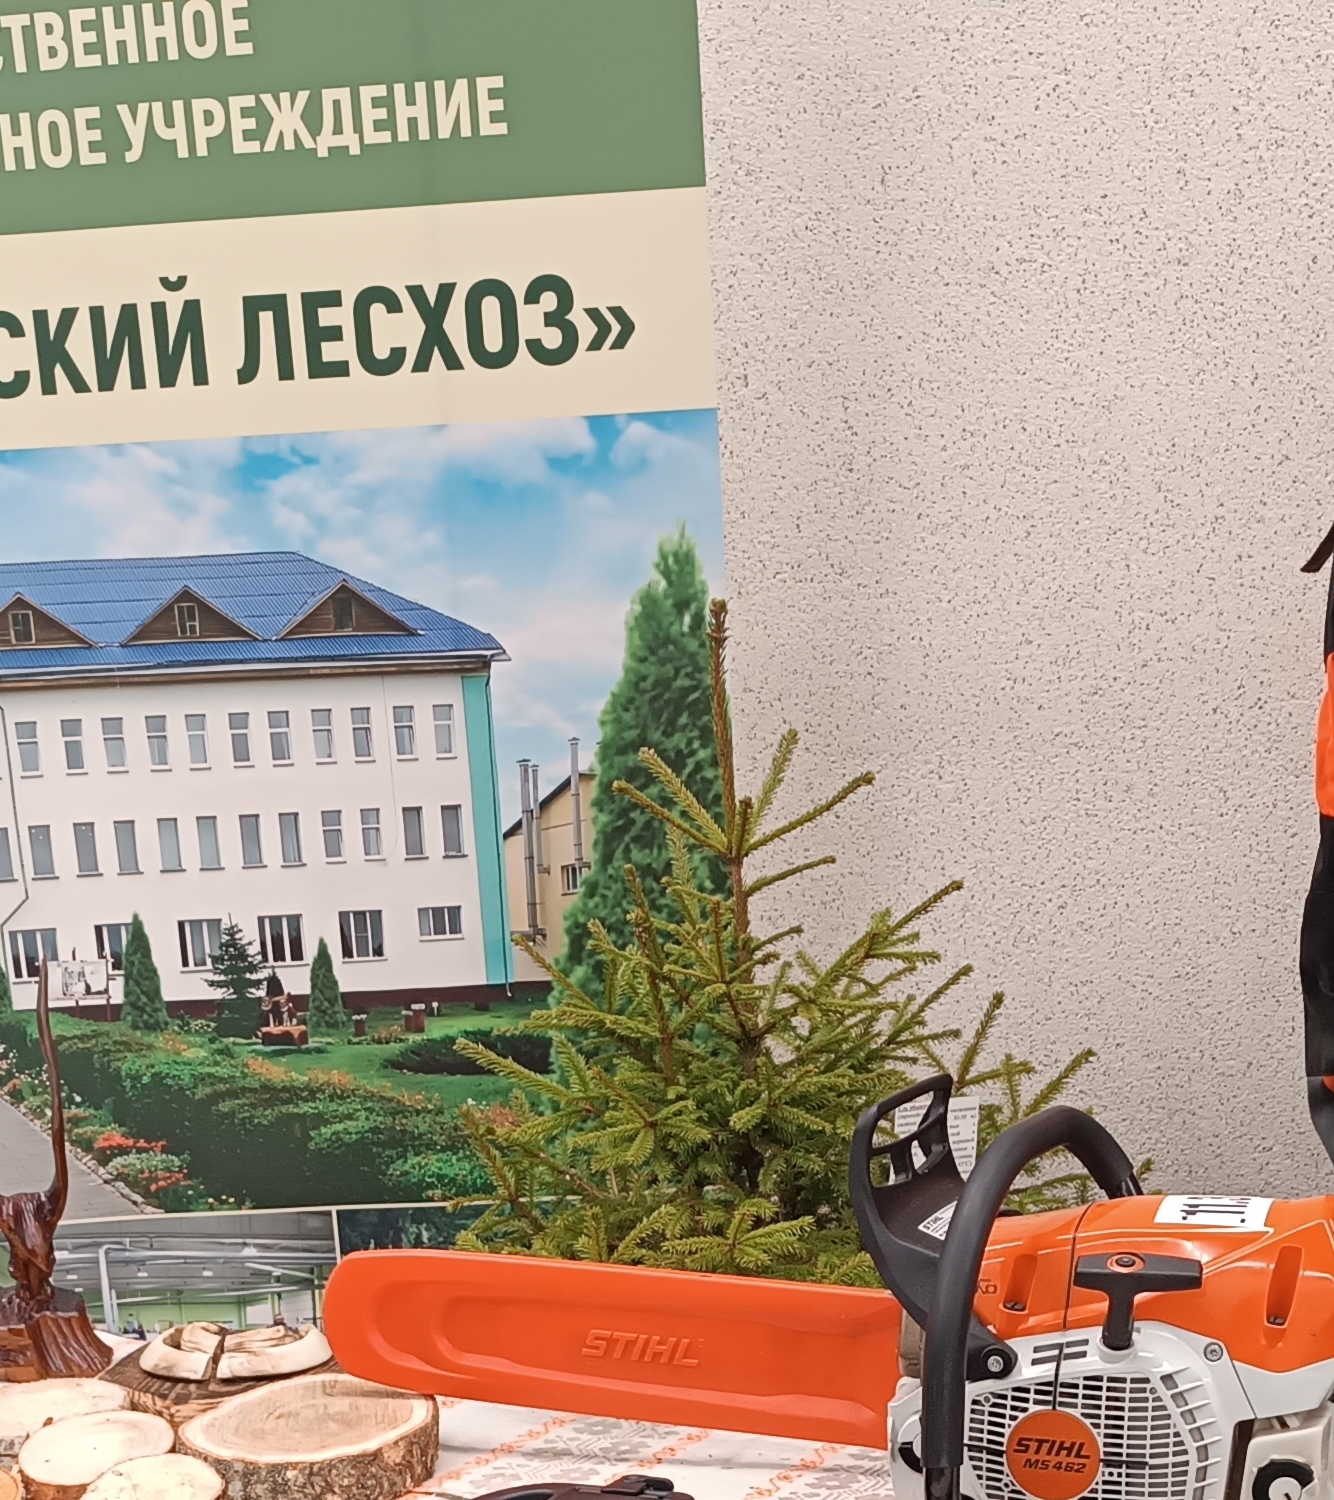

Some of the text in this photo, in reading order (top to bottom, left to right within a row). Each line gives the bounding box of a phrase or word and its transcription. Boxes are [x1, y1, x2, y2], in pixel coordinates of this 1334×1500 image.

[116, 75, 509, 164] УЧРЕЖДЕНИЕ
[235, 273, 637, 386] ЛЕСХОЗ»
[922, 1214, 945, 1231] STIHL
[582, 1329, 700, 1367] STIHL
[1013, 1436, 1092, 1460] STIHL
[1023, 1458, 1087, 1474] MS 462
